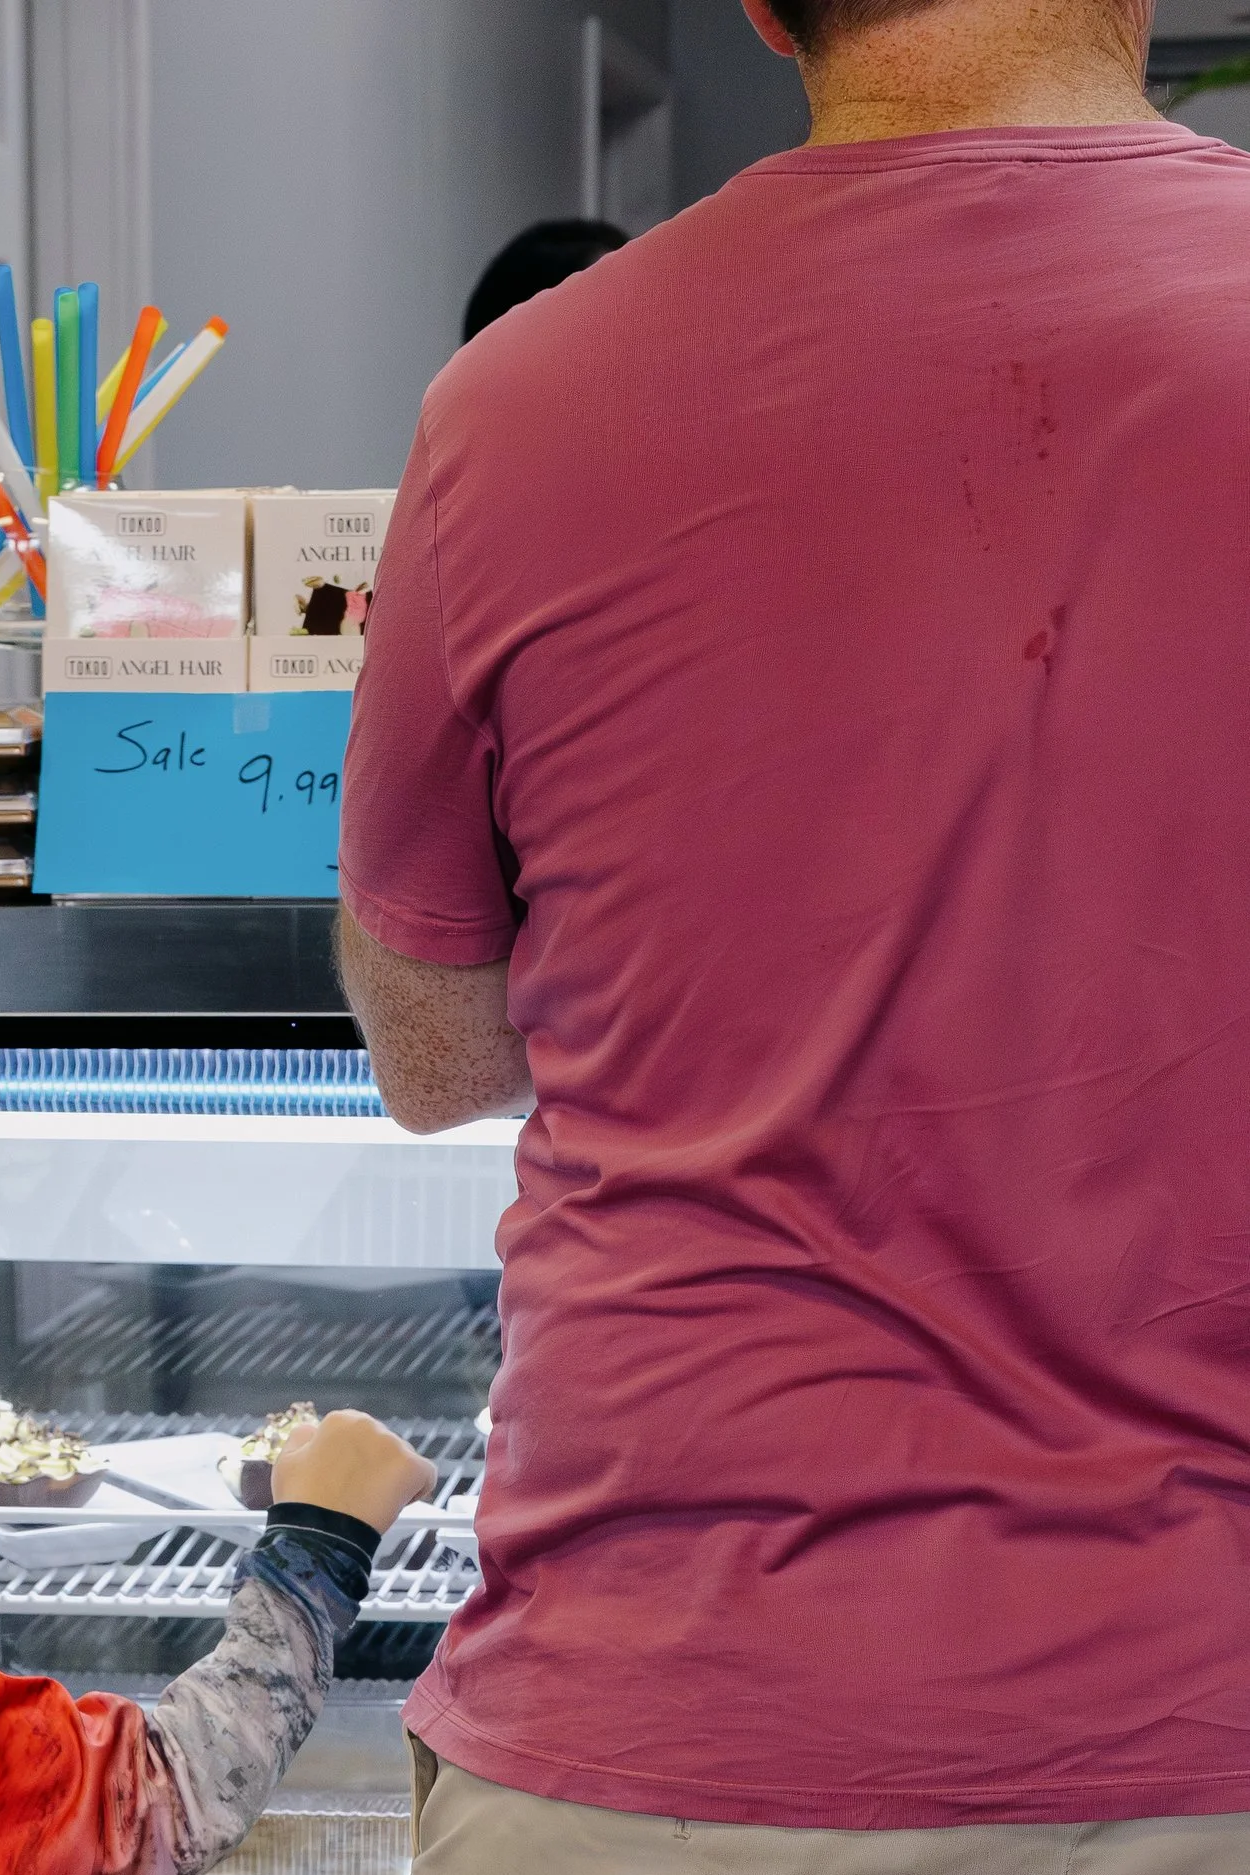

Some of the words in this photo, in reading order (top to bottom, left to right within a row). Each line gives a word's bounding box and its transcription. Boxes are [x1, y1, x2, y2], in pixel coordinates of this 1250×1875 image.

[121, 517, 162, 533] TOKOO
[329, 518, 371, 533] TOKOO
[152, 545, 196, 561] HAIR
[296, 547, 354, 562] ANGEL
[69, 660, 108, 676] TOKOO
[117, 660, 174, 676] ANGEL
[179, 660, 223, 676] HAIR
[275, 659, 314, 675] TOKOO
[94, 721, 206, 772] Sale
[239, 755, 340, 814] 9.99
